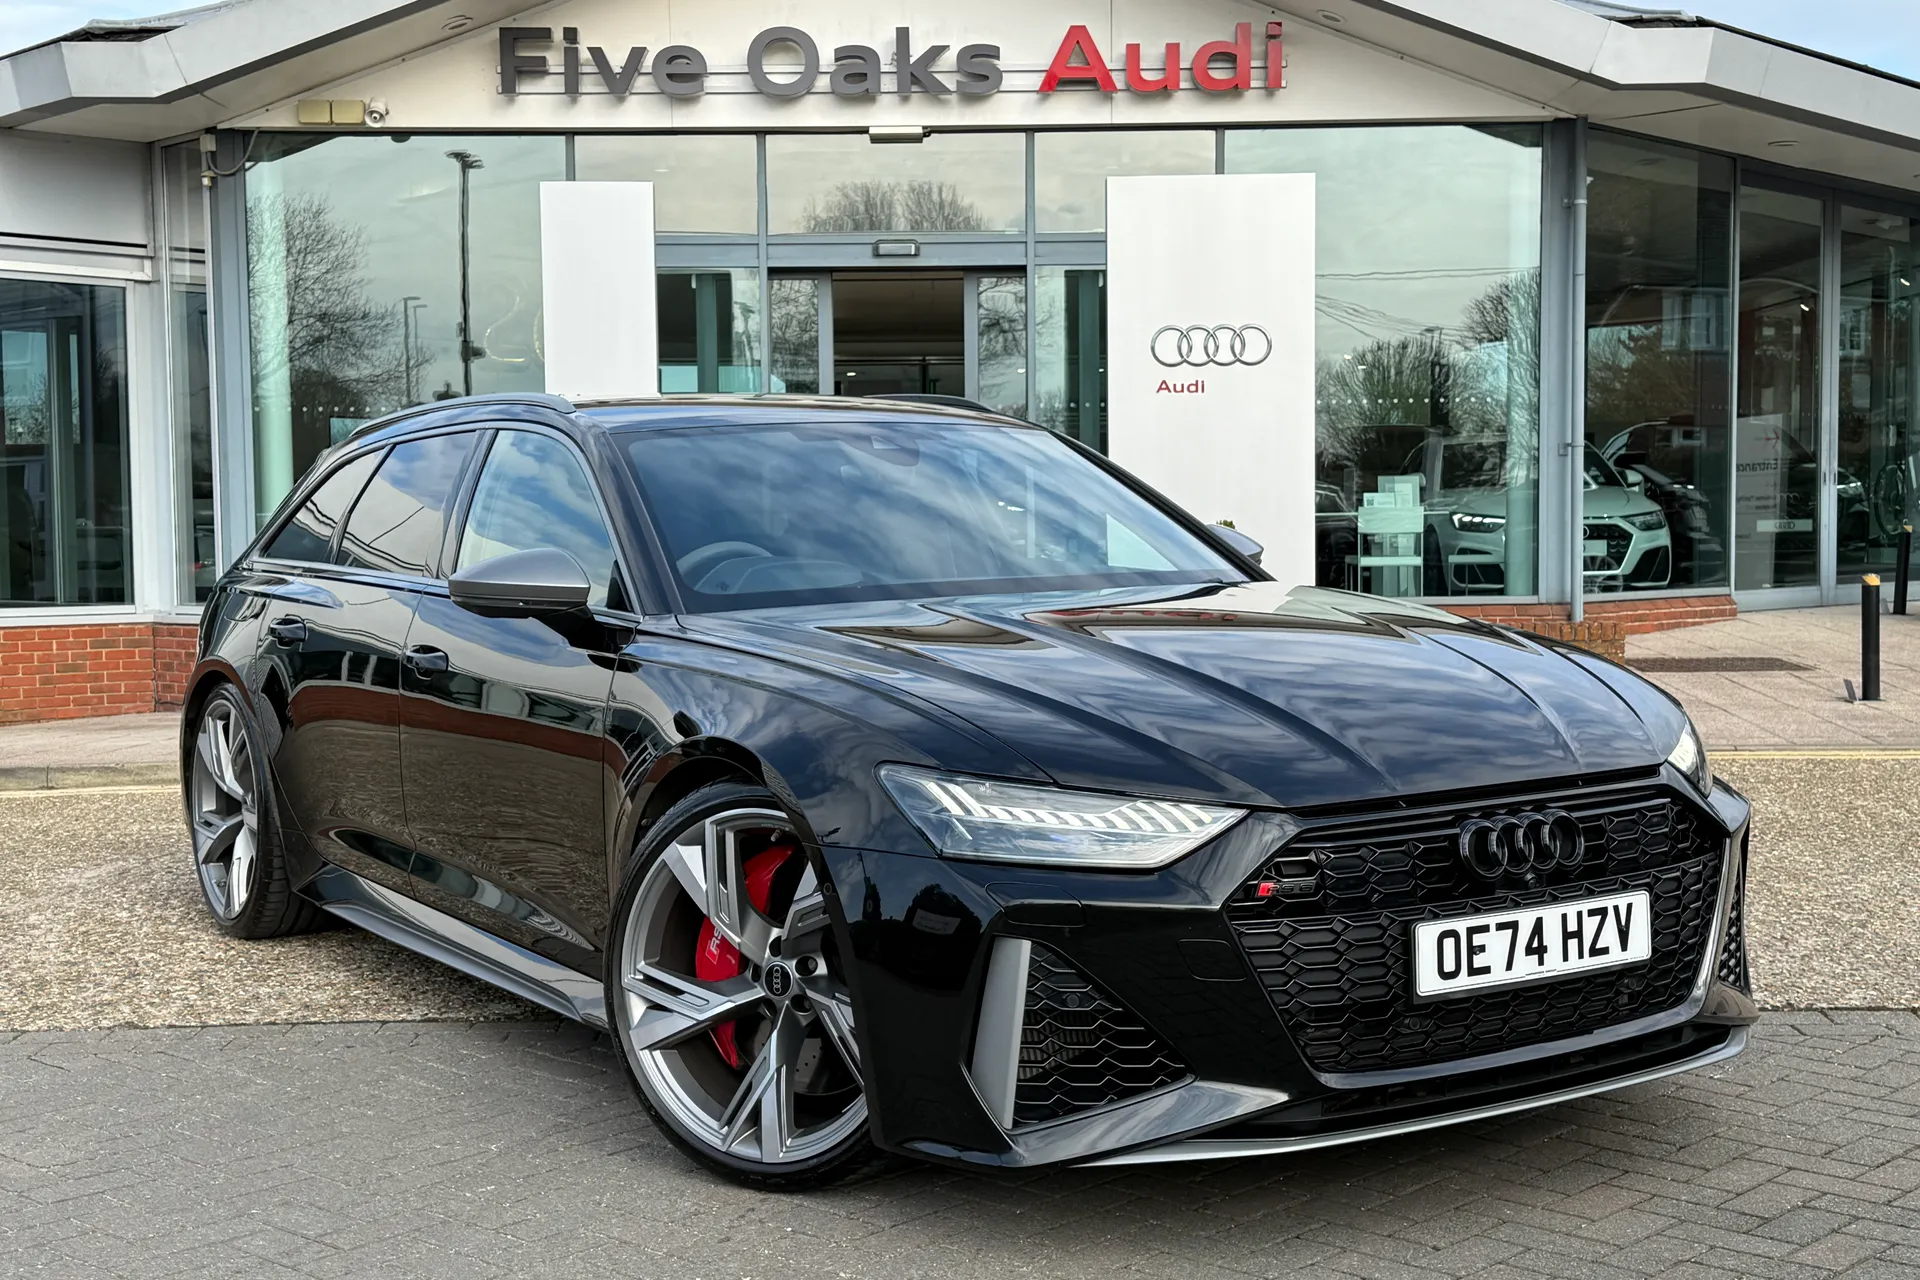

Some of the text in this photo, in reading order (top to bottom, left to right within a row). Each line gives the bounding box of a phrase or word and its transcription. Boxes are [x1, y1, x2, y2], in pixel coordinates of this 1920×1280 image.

[499, 22, 1283, 96] Five Oaks Audi
[1156, 380, 1205, 394] Audi
[1437, 902, 1634, 981] OE74 HZV
